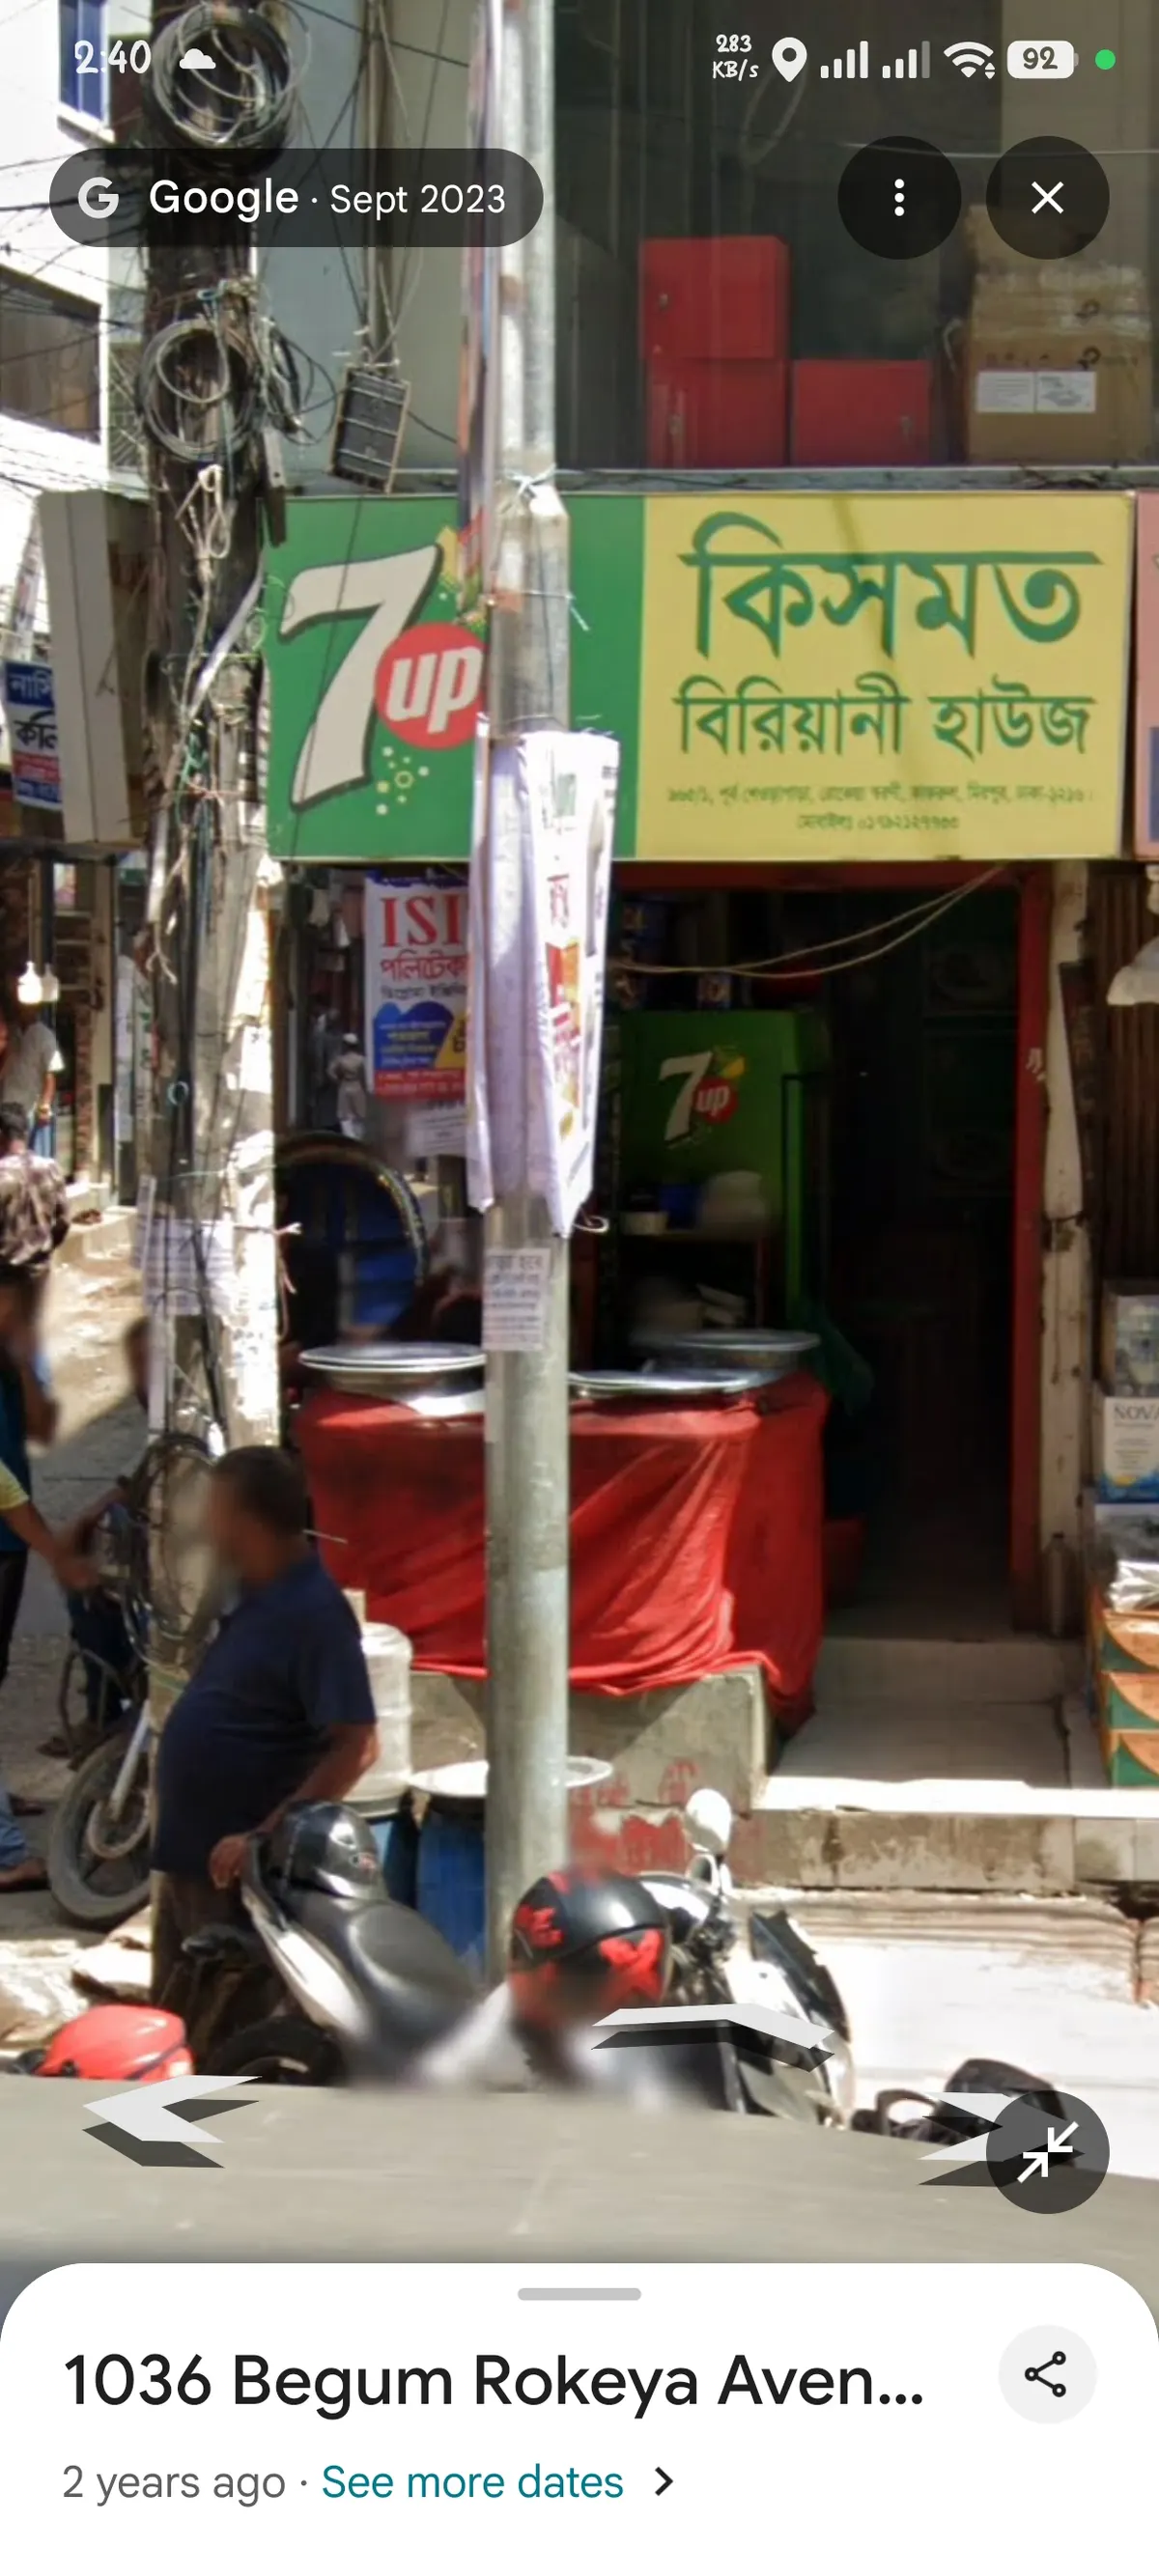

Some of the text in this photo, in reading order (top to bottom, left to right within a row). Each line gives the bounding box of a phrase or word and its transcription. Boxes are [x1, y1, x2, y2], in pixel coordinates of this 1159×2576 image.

[677, 511, 1104, 659] কিসমত
[671, 672, 1097, 762] বিরিয়ানী হাউজ
[381, 948, 468, 983] পলিটেক
